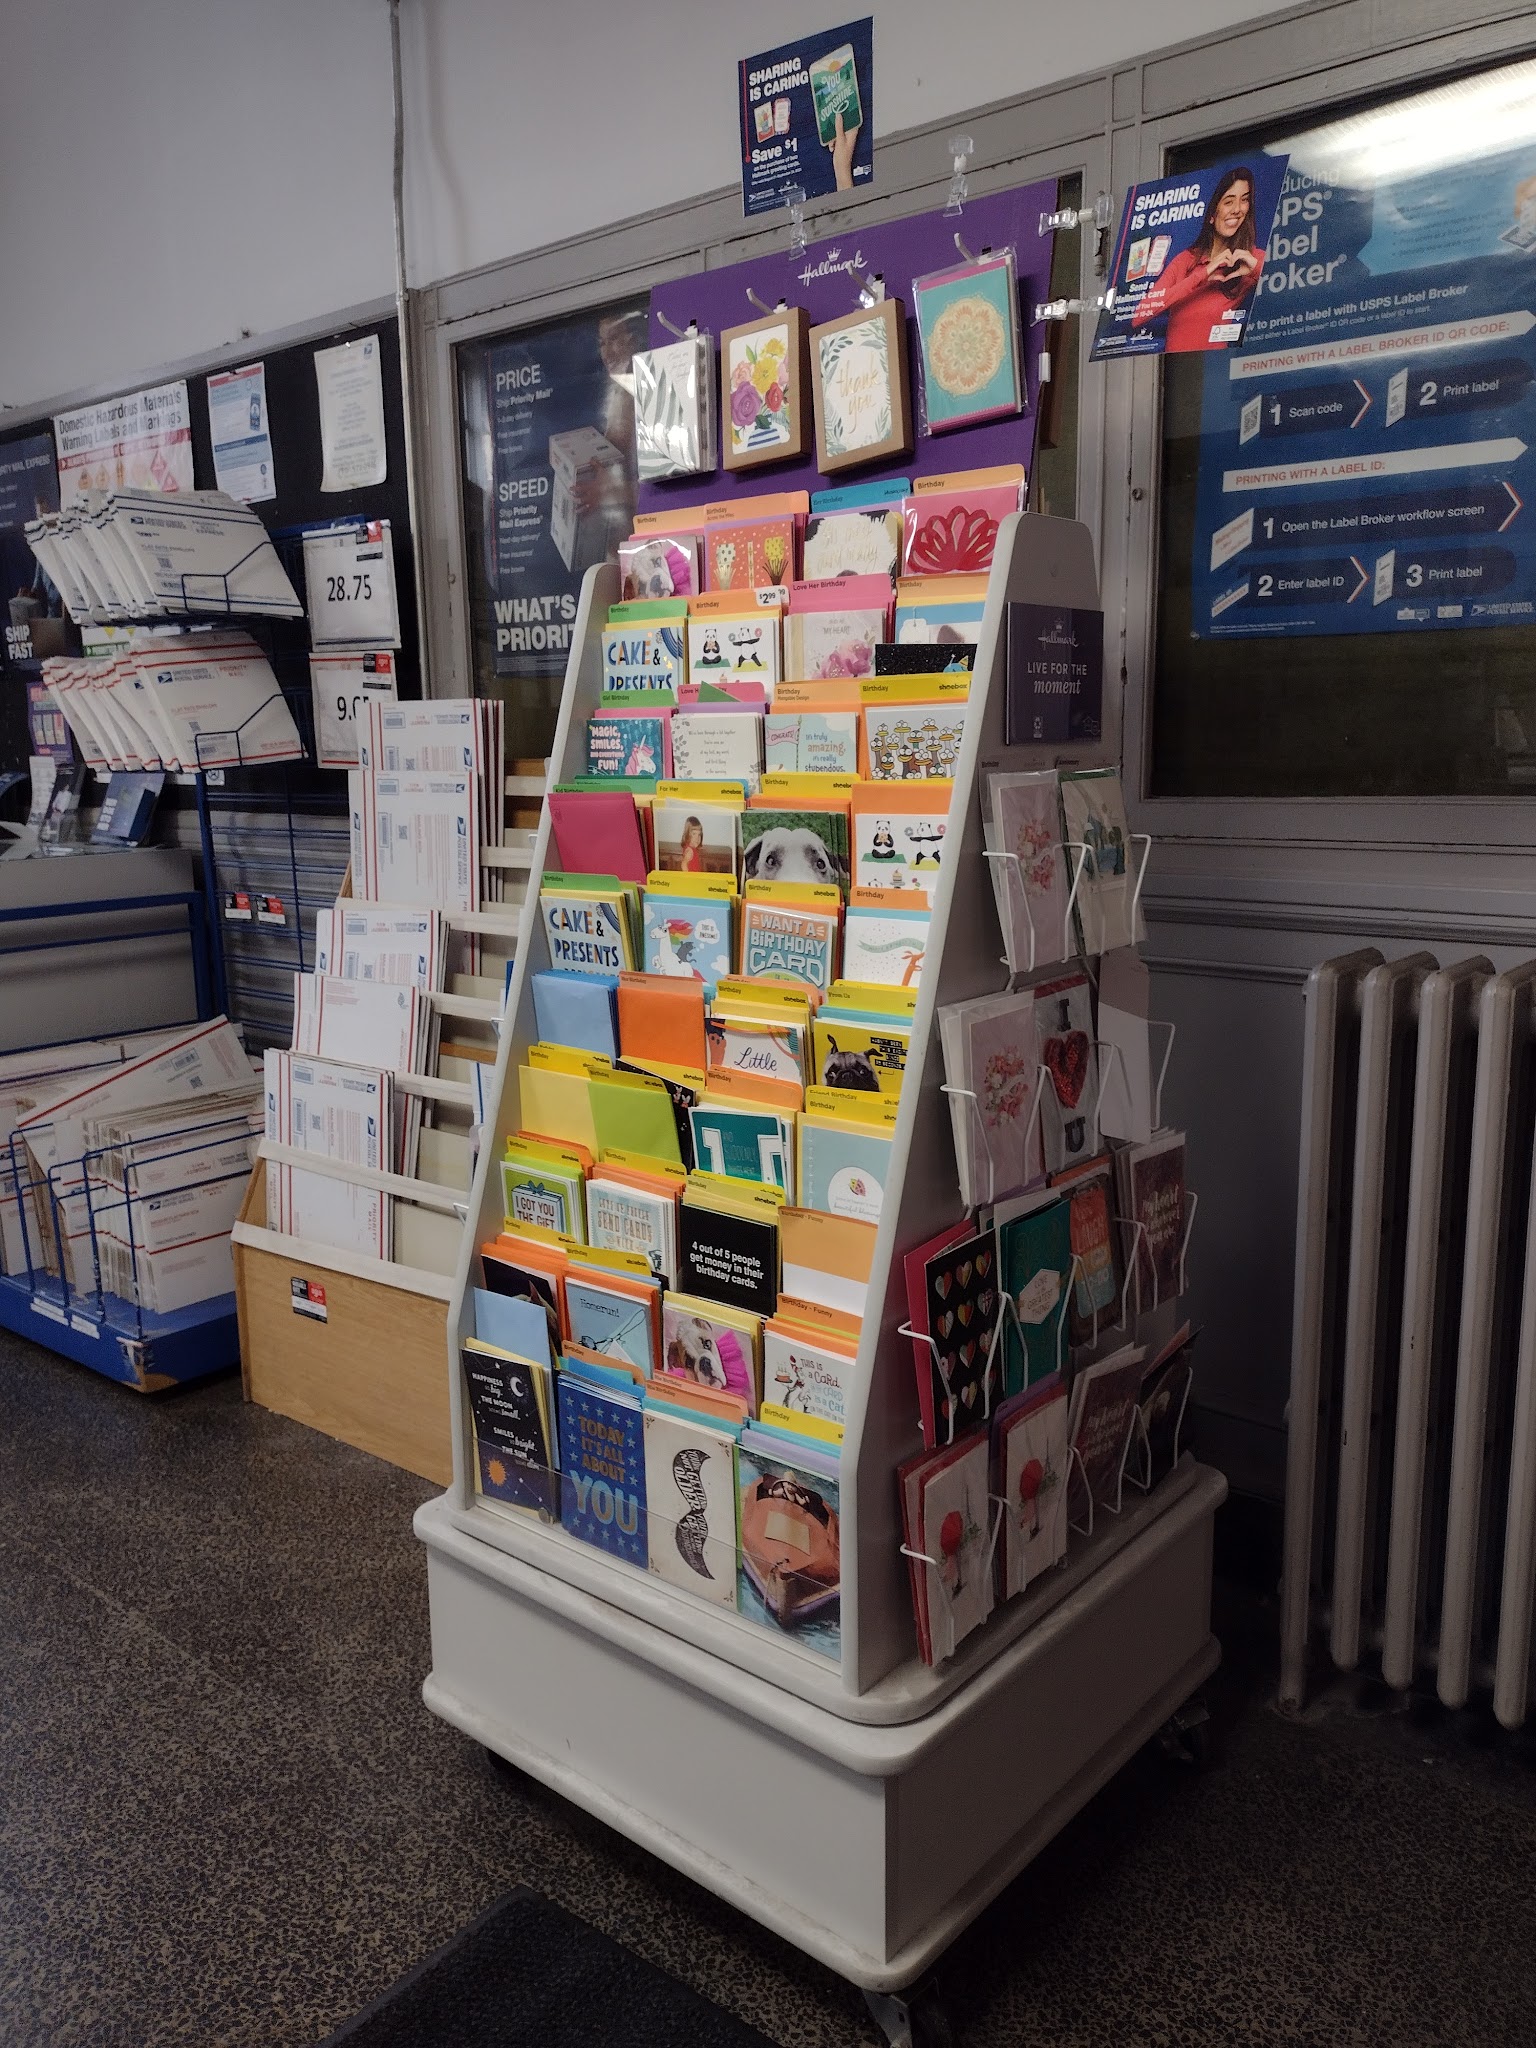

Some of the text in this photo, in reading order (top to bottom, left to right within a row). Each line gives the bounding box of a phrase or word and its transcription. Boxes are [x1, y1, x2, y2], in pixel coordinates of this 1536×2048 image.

[748, 57, 801, 86] SHARING
[750, 70, 809, 102] IS CARING
[752, 137, 798, 164] Save $1
[1135, 184, 1200, 212] SHARING
[1131, 201, 1205, 231] IS CARING
[797, 250, 868, 287] Hallmark
[1129, 281, 1148, 292] Send
[1148, 288, 1166, 298] card
[1257, 321, 1267, 330] to
[1269, 314, 1295, 330] print
[1306, 306, 1331, 320] label
[1334, 303, 1357, 316] with
[1360, 296, 1391, 312] USPS
[1395, 289, 1426, 308] Label
[1429, 283, 1468, 302] Broker
[1242, 320, 1510, 373] PRINTING WITH A LABEL BROKER ID CODE:
[496, 364, 541, 392] PRICE
[511, 392, 535, 406] Priority
[1420, 378, 1499, 406] 2 Print label
[1270, 401, 1343, 426] 1 Scan code
[1236, 460, 1385, 486] PRINTING WITH A LABEL ID:
[500, 476, 548, 502] SPEED
[917, 480, 944, 489] Birthday
[513, 505, 537, 517] Priority
[637, 516, 657, 524] Birthday
[706, 507, 727, 516] Birthday
[500, 519, 513, 529] Mail
[1263, 504, 1485, 539] 1 Open the Label Broker workflow screen
[793, 583, 807, 591] Love
[820, 579, 846, 589] Birthday
[1257, 574, 1345, 597] 2 Enter label ID
[1406, 564, 1482, 588] 3 Print label
[327, 573, 372, 602] 28.75
[494, 595, 576, 624] WHAT'S
[696, 600, 720, 609] Birthday
[5, 624, 31, 643] SHIP
[1038, 627, 1081, 650] Hallmark
[8, 641, 33, 660] FAST
[608, 641, 661, 666] CAKE &
[1027, 662, 1087, 676] LIVE FOR THE
[1033, 680, 1082, 695] moment
[765, 779, 788, 787] Birthday
[649, 880, 670, 888] Birthday
[748, 884, 771, 893] Birthday
[857, 890, 885, 899] Birthday
[549, 907, 604, 937] CAKE &
[760, 913, 817, 938] WANT A
[554, 938, 619, 967] PRESENTS
[750, 929, 828, 958] BIRTHDAY
[749, 948, 825, 987] CARD
[719, 984, 806, 1004] Birthday shoebox
[530, 1050, 549, 1059] Birthday
[734, 1046, 777, 1071] Little
[590, 1069, 609, 1078] Birthday
[683, 1073, 703, 1081] shoebox
[708, 1072, 731, 1082] Birthday
[810, 1101, 835, 1111] Birthday
[830, 1092, 857, 1100] Birthday
[509, 1140, 528, 1150] Birthday
[605, 1151, 626, 1161] Birthday
[515, 1196, 555, 1217] I GOT YOU
[754, 1196, 776, 1205] shoebox
[517, 1210, 555, 1230] THE GIFT
[566, 1248, 588, 1257] Birthday
[692, 1240, 761, 1268] 4 out of 5 people
[690, 1253, 764, 1280] get money in their
[696, 1263, 758, 1290] birthday cards.
[782, 1298, 832, 1318] Birthday Funny
[564, 1345, 584, 1356] Birthday
[801, 1359, 823, 1371] THIS IS
[493, 1399, 513, 1410] MOON
[764, 1408, 790, 1421] Birthday
[493, 1426, 514, 1438] SMILES
[579, 1415, 625, 1447] TODAY
[605, 1444, 625, 1465] ALL
[581, 1453, 626, 1483] ABOUT
[570, 1469, 639, 1536] YOU
